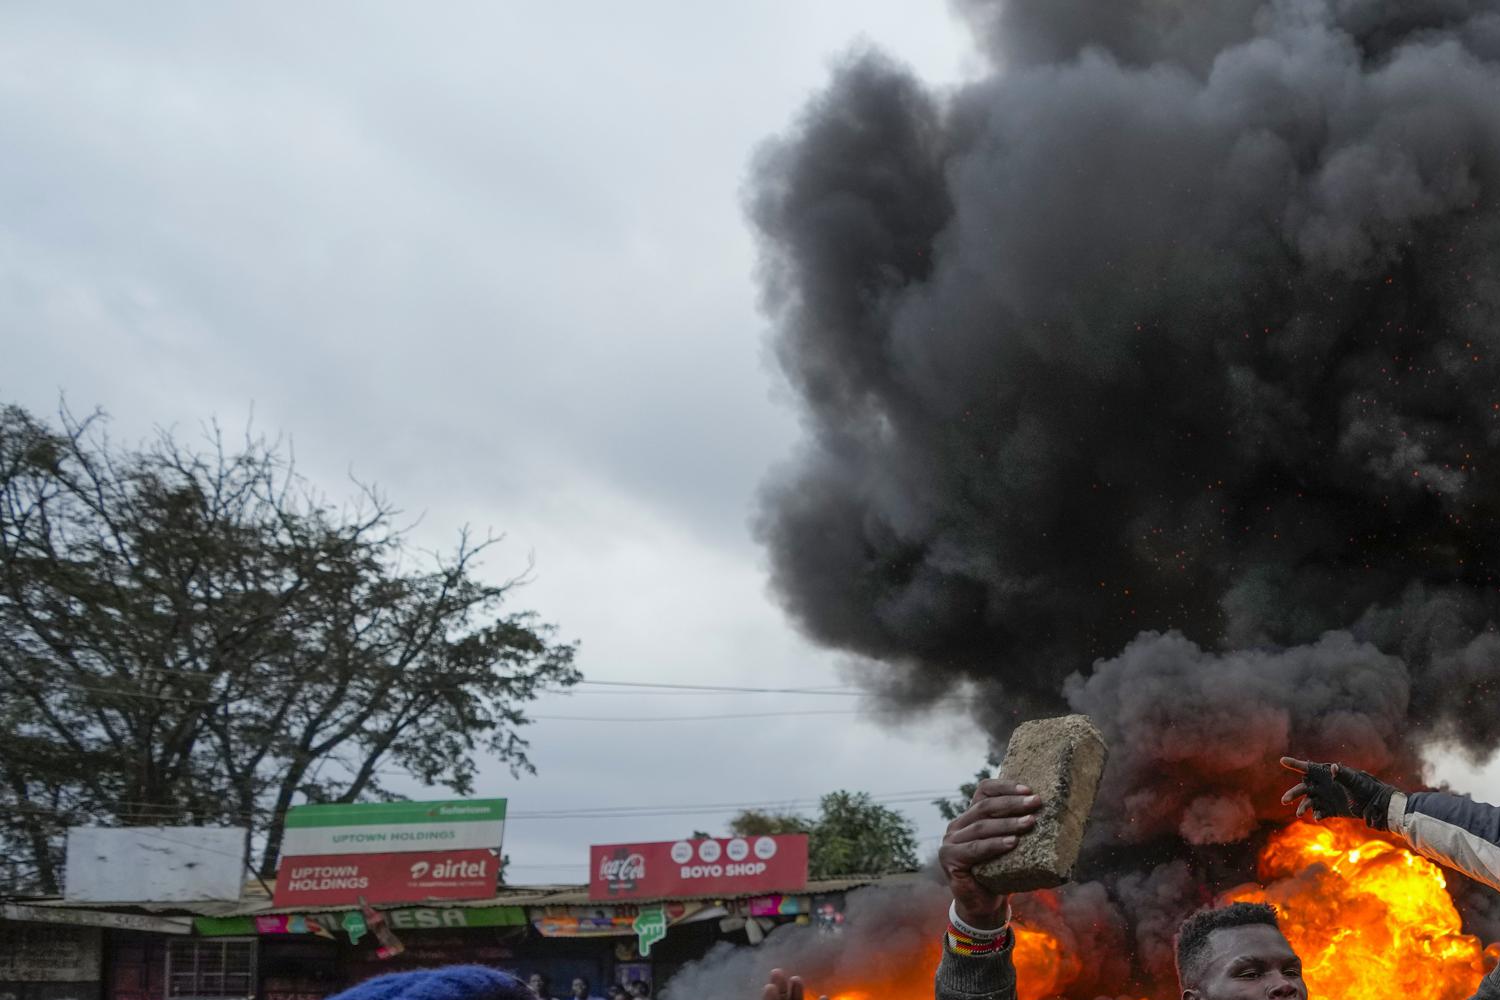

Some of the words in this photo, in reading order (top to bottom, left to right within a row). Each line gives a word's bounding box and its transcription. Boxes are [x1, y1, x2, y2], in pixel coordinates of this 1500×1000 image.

[332, 832, 386, 844] UPTOWN
[390, 830, 456, 842] HOLDINGS
[290, 866, 358, 880] UPTOWN
[432, 859, 487, 878] airtel
[680, 866, 723, 879] BOYO
[725, 862, 767, 877] SHOP
[288, 877, 369, 892] HOLDINGS
